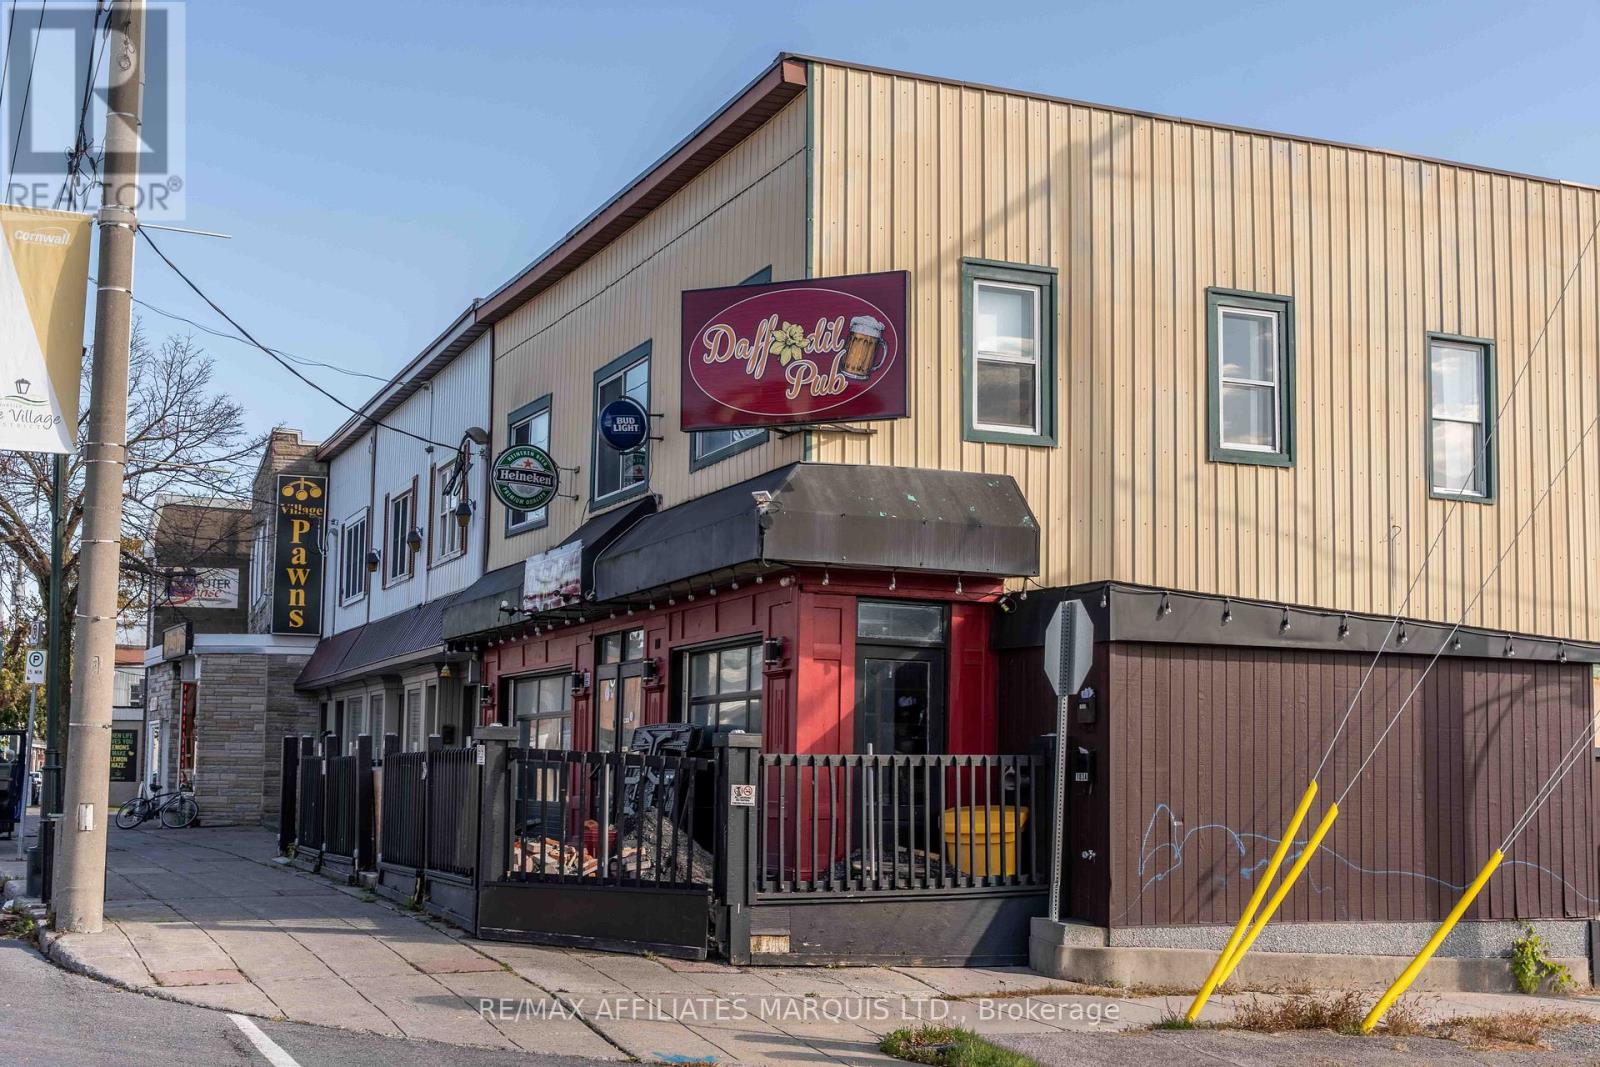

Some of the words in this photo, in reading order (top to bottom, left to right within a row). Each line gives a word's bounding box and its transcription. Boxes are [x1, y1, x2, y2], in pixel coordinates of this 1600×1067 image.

[702, 314, 846, 381] Daffdil
[785, 349, 849, 401] Pub
[9, 408, 62, 430] Village
[613, 424, 639, 432] LIGHT
[500, 470, 551, 485] Heineken
[502, 487, 524, 504] PREMIUM
[281, 503, 323, 519] Village
[286, 519, 310, 629] Pawns
